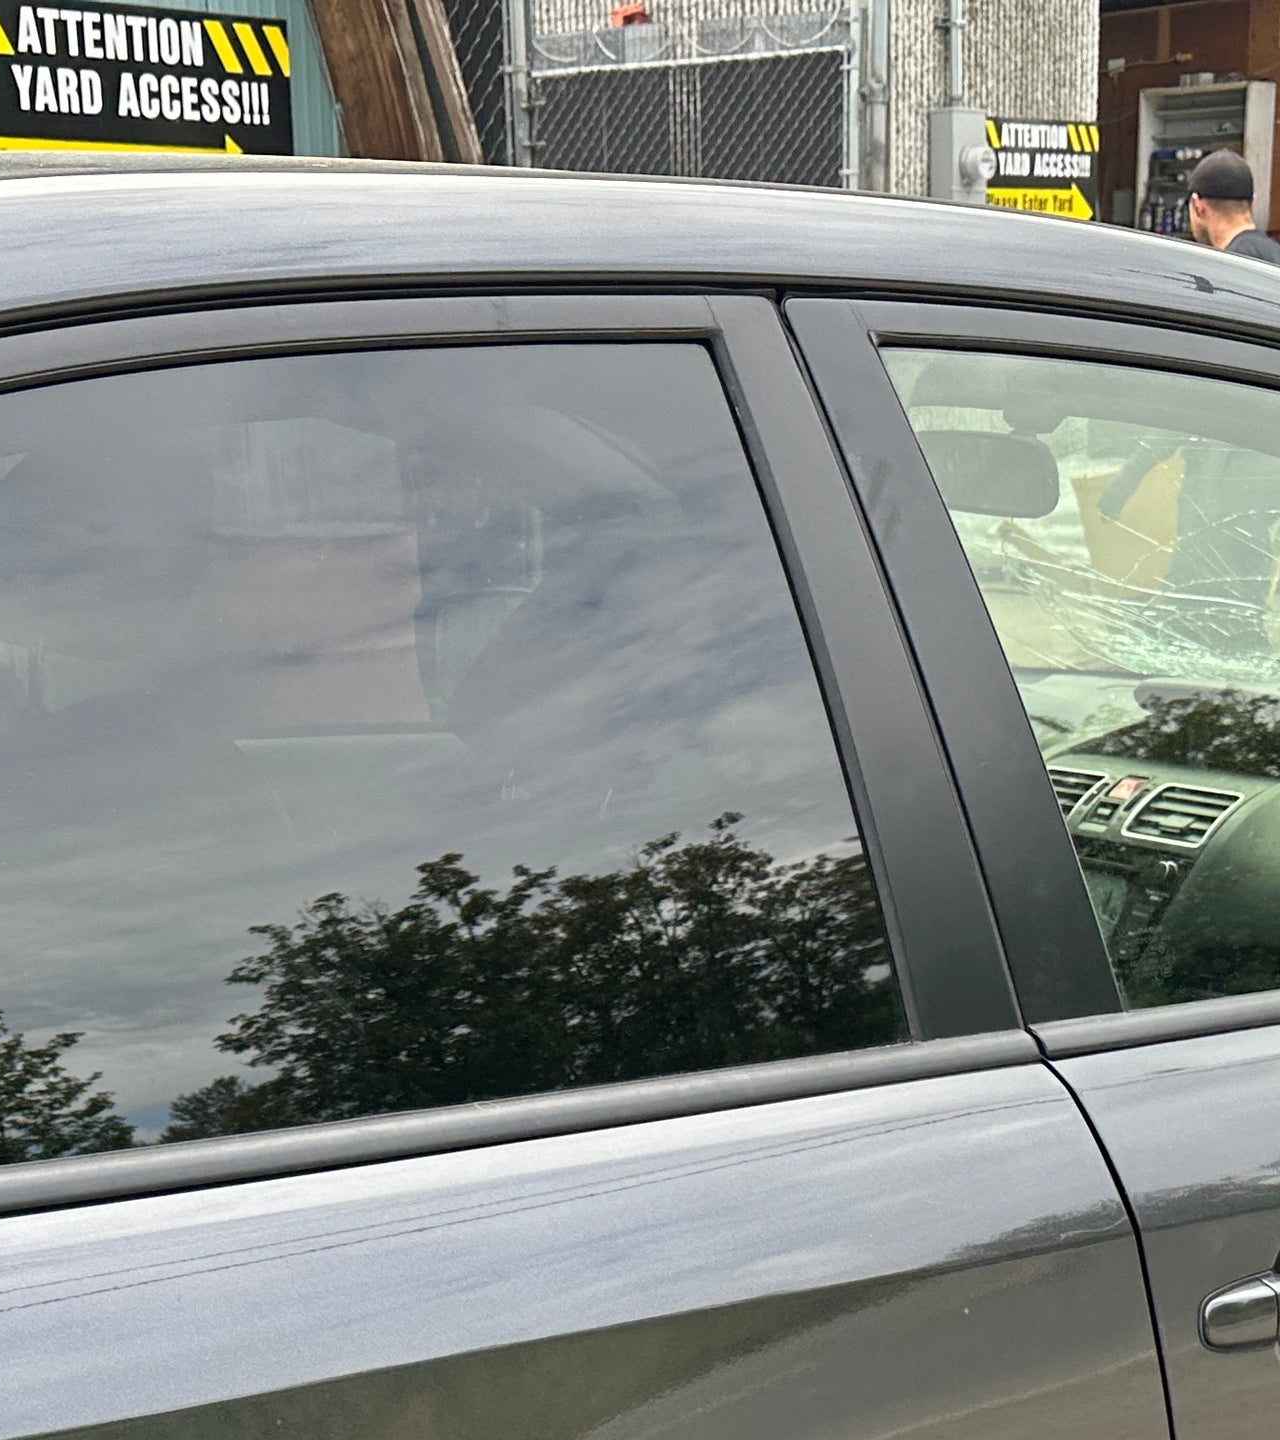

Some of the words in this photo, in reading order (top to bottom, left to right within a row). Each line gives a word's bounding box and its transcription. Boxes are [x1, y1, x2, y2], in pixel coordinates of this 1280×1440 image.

[18, 6, 204, 67] ATTENTION
[12, 64, 103, 116] YARD
[119, 75, 271, 126] ACCESS!!!
[1001, 122, 1068, 150] ATTENTION
[998, 152, 1030, 177] YARD
[1033, 153, 1091, 178] ACCESS!!!
